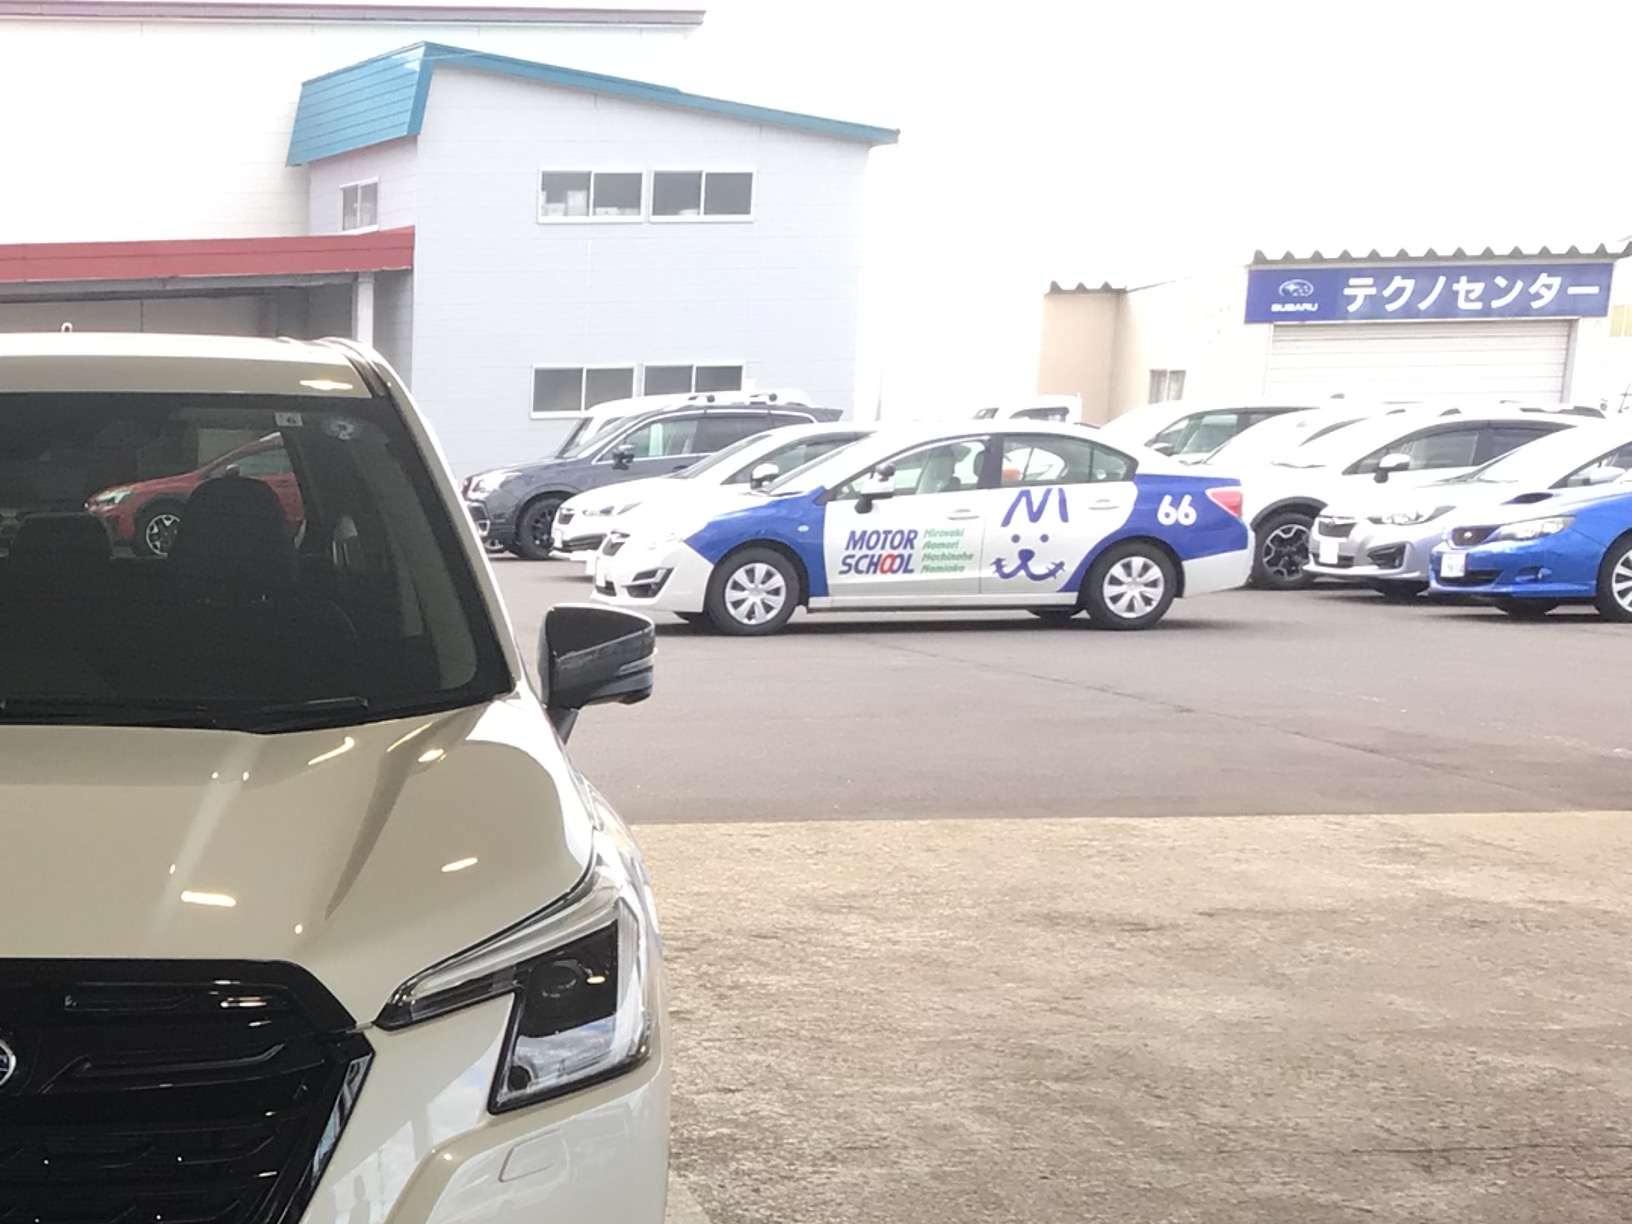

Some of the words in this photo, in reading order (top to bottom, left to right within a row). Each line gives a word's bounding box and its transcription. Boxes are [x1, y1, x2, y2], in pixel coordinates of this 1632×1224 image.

[1342, 272, 1600, 312] テクノセンター
[1271, 303, 1319, 312] SUBARU
[1157, 495, 1198, 526] 66
[845, 529, 919, 551] MOTOR
[838, 553, 917, 575] SCHOOL
